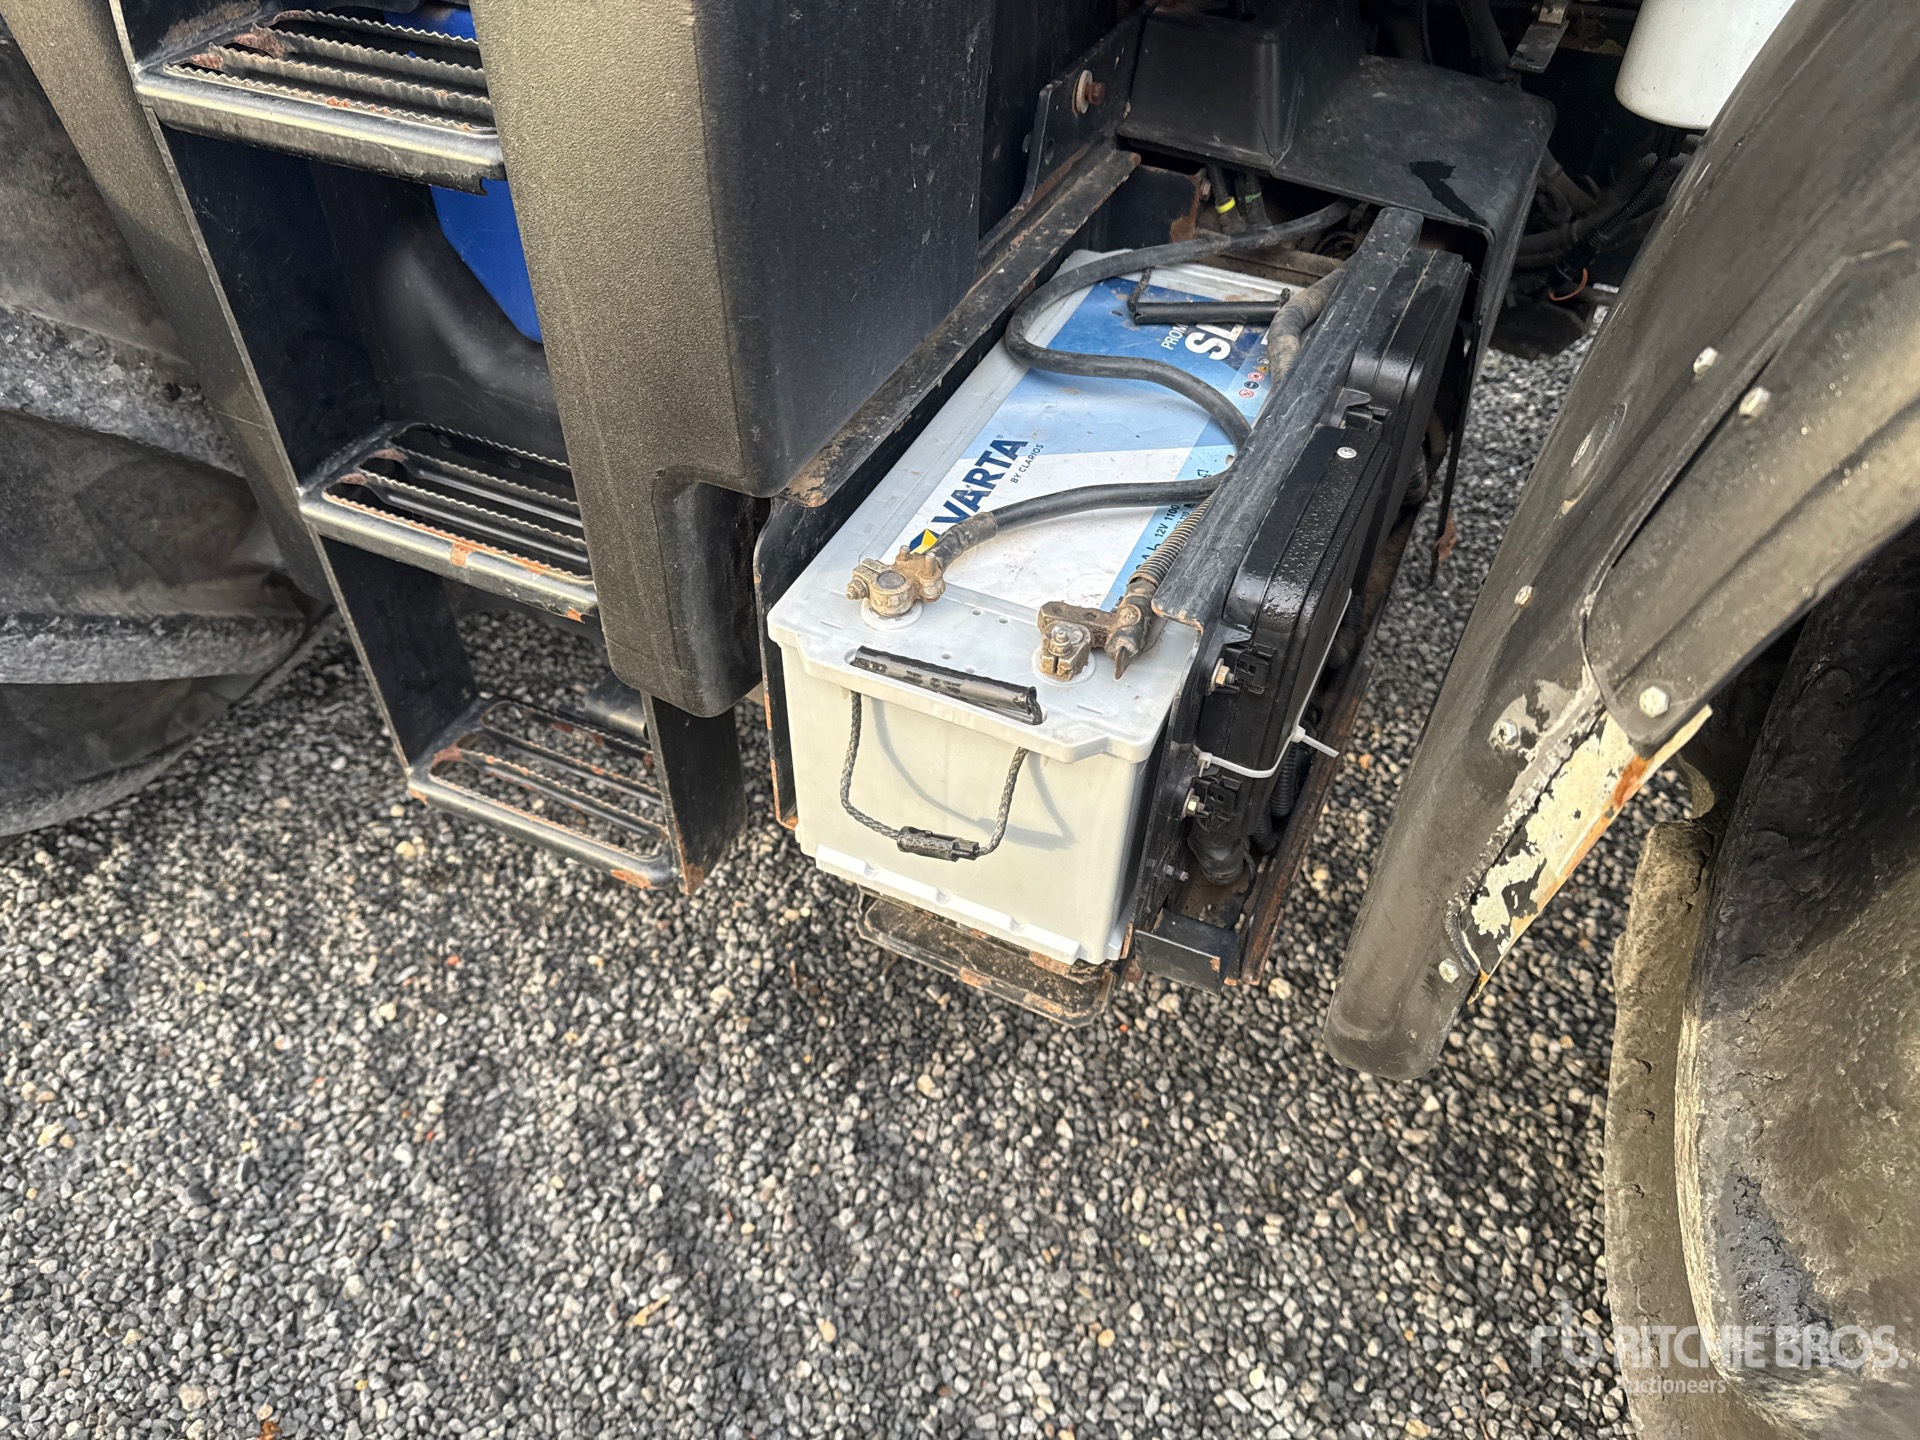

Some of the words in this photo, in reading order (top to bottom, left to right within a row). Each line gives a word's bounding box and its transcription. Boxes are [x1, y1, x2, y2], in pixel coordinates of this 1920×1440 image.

[930, 439, 1029, 524] VARTA
[1010, 473, 1022, 484] BY
[1018, 443, 1044, 473] CLARIOS
[1154, 523, 1169, 538] 12V
[1164, 504, 1181, 521] 1100
